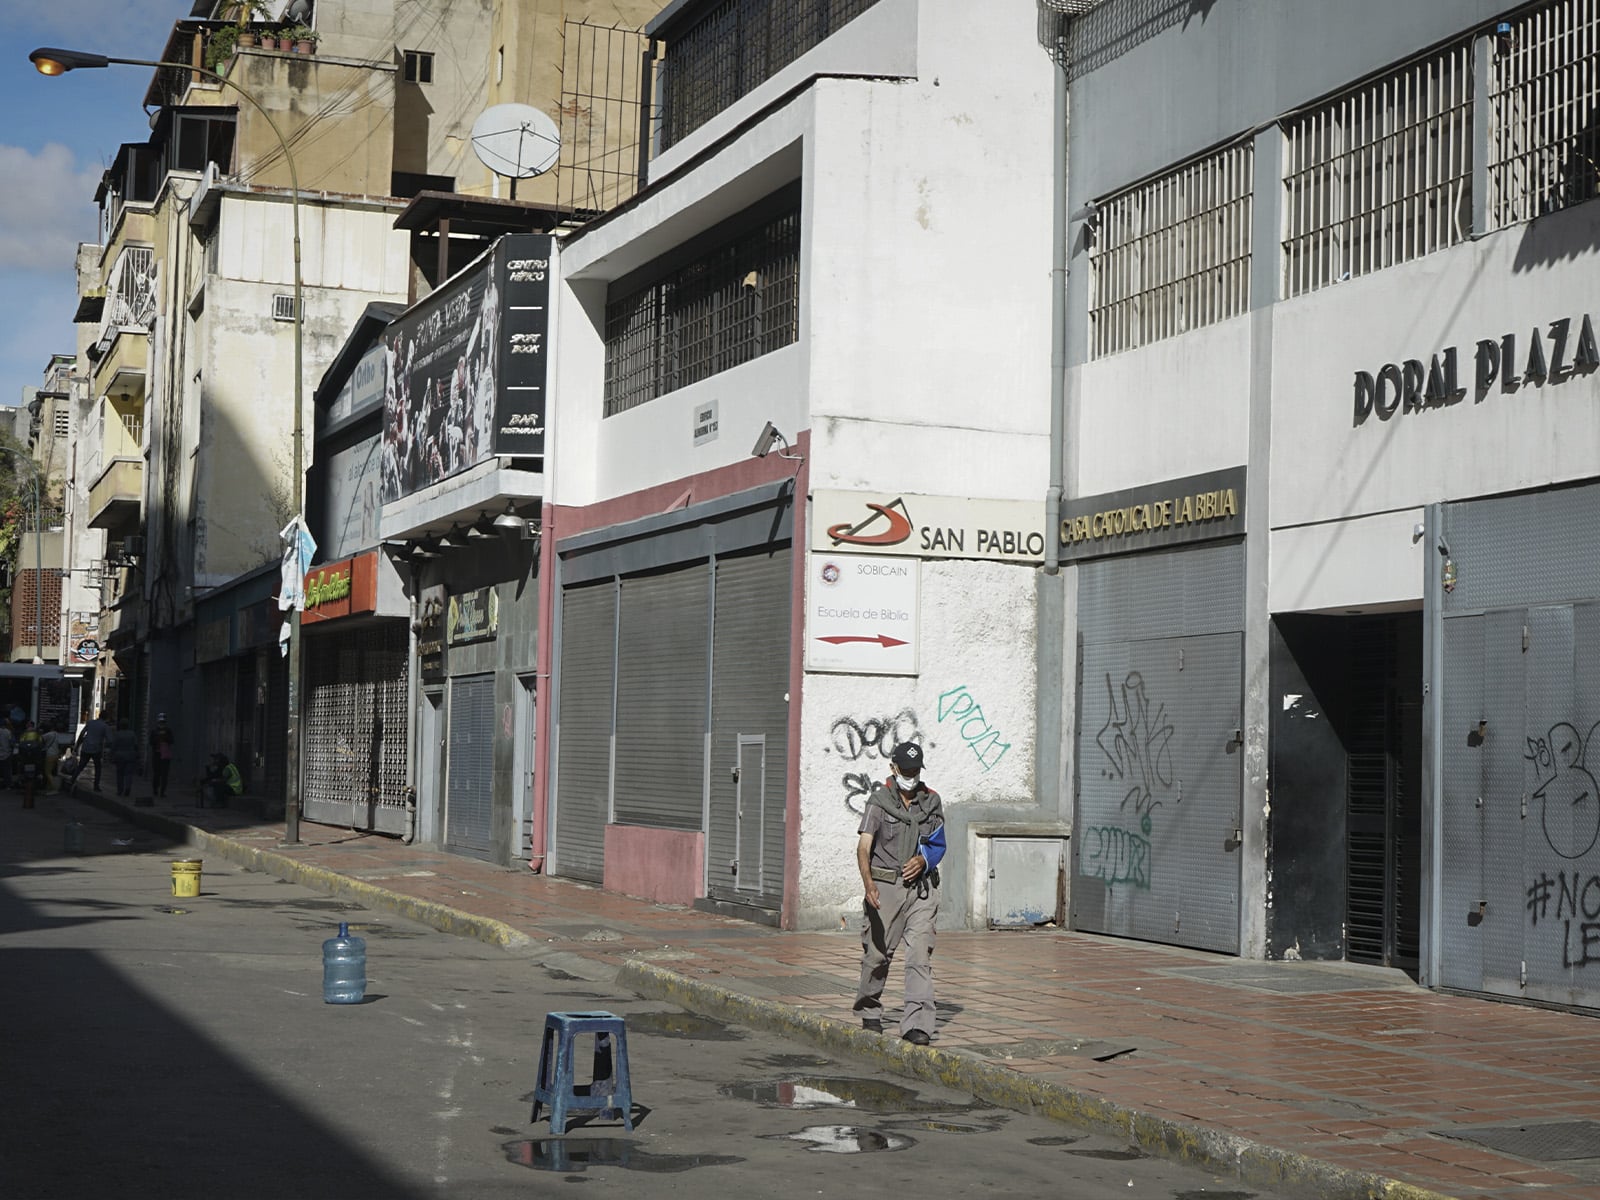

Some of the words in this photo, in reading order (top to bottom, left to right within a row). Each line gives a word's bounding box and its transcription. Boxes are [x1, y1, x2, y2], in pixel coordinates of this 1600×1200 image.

[507, 259, 548, 271] CENTRO
[509, 333, 541, 344] SPORT
[511, 344, 540, 354] BOOK
[1353, 346, 1467, 427] DORAL
[1474, 313, 1600, 405] PLAZA
[508, 413, 539, 426] BAR
[1060, 515, 1091, 543] CASA
[1092, 504, 1151, 538] CATOLICA
[1153, 500, 1173, 527] DE
[1174, 496, 1193, 524] LA
[1195, 488, 1238, 520] BIBLIA
[920, 526, 964, 552] SAN
[977, 530, 1044, 555] PABLO
[857, 564, 908, 576] SOBICAIN
[818, 606, 860, 619] Escuela
[862, 608, 878, 620] de
[880, 608, 909, 621] Biblia
